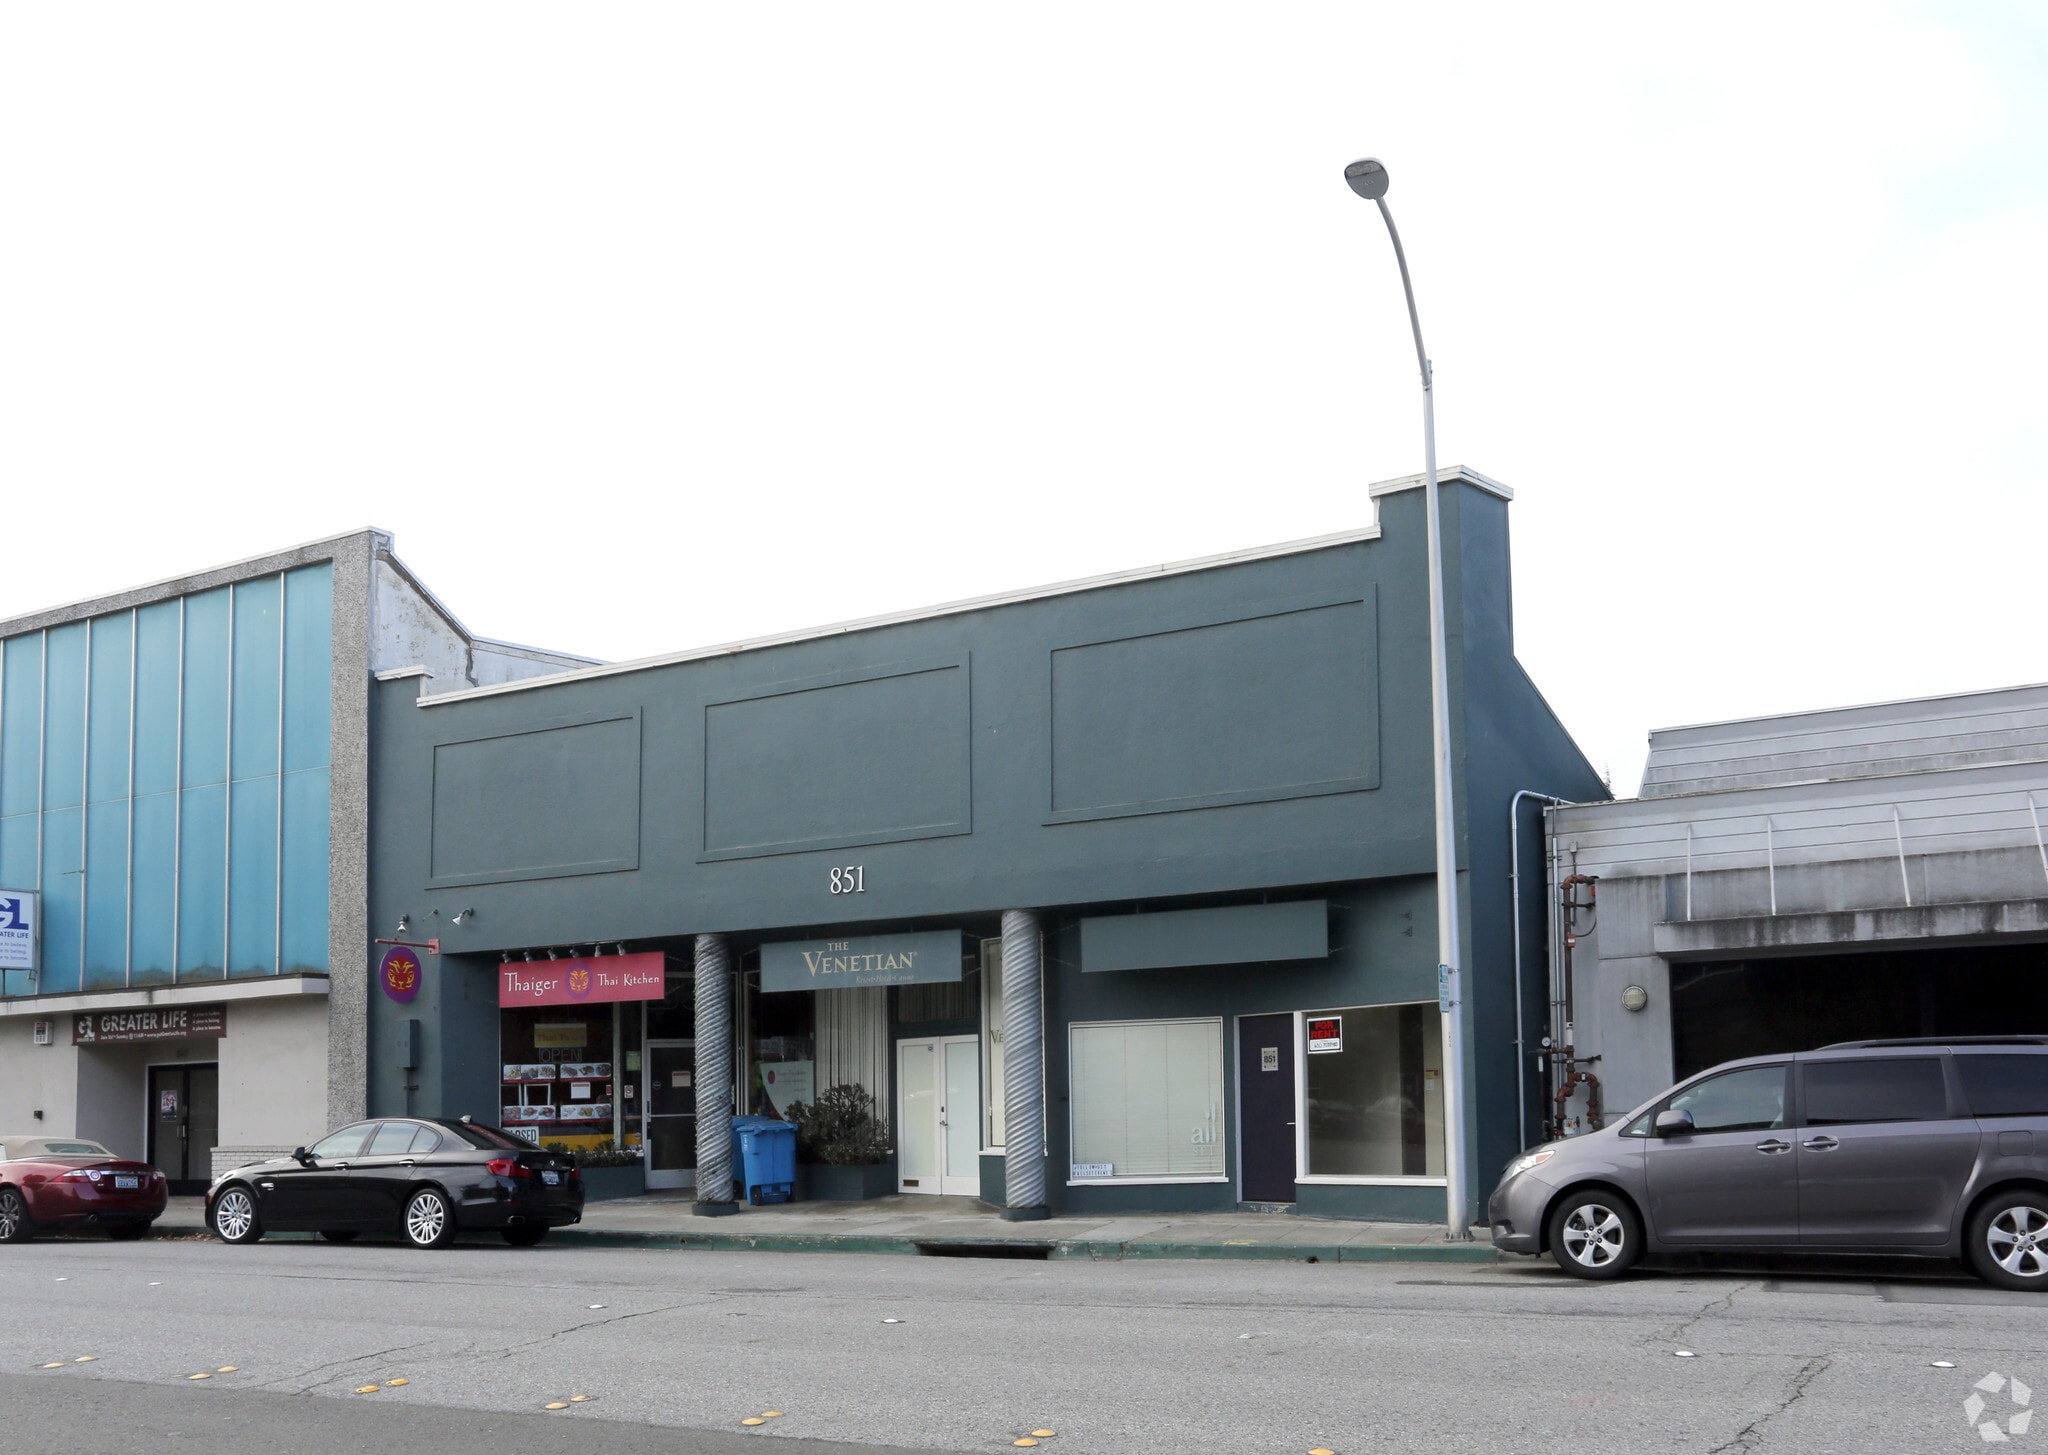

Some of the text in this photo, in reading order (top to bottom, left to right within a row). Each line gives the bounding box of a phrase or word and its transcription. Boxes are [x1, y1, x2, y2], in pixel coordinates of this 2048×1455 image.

[830, 865, 865, 894] 851
[827, 941, 849, 951] THE
[504, 972, 659, 996] Thaiger Thai Kitchen
[101, 1010, 187, 1032] GREATER LIFE
[1315, 1021, 1333, 1029] FOR
[1310, 1029, 1338, 1039] RENT
[541, 1048, 580, 1062] OPEN
[1263, 1055, 1276, 1063] 851
